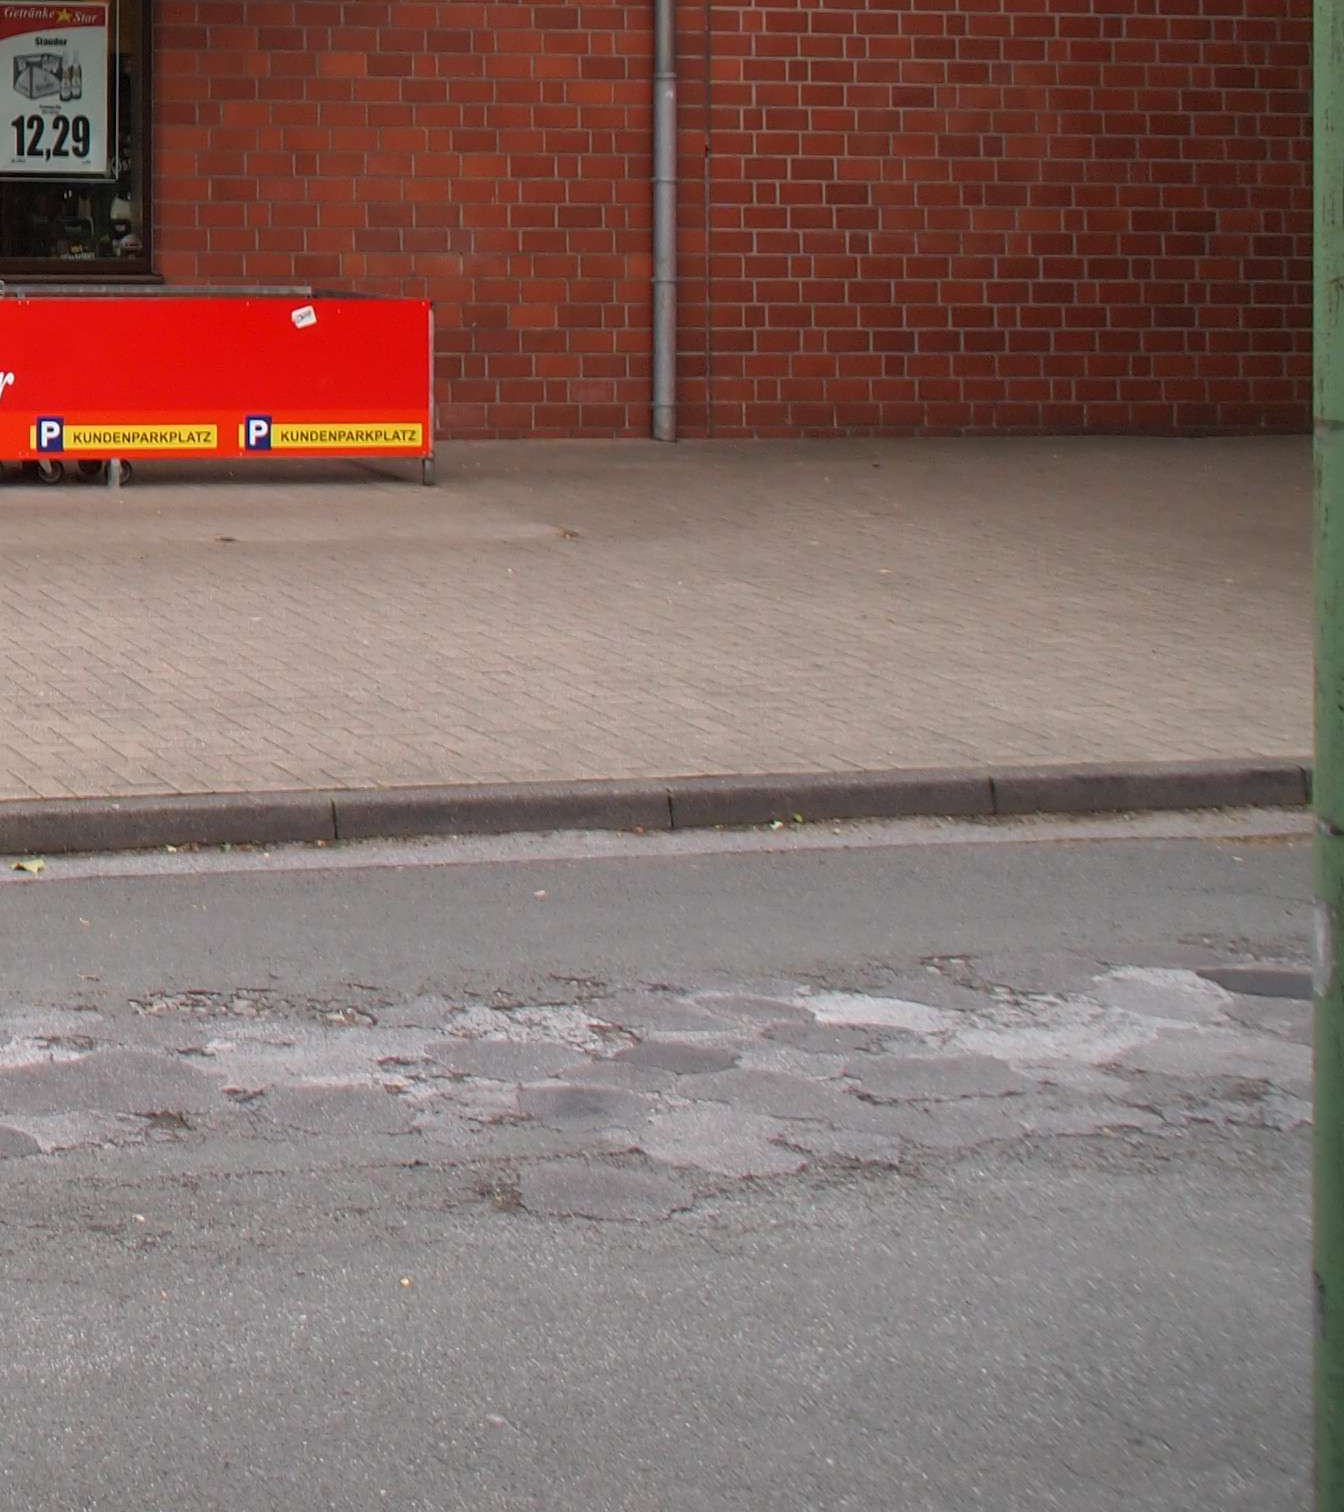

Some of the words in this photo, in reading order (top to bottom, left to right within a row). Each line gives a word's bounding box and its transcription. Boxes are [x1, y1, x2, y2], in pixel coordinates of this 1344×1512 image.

[4, 6, 56, 20] Getränke
[73, 10, 98, 24] Star
[10, 114, 90, 162] 12,29
[41, 420, 61, 447] P
[73, 431, 212, 444] KUNDENPARKPLATZ
[249, 419, 269, 445] P
[280, 429, 417, 442] KUNDENPARKPLATZ
